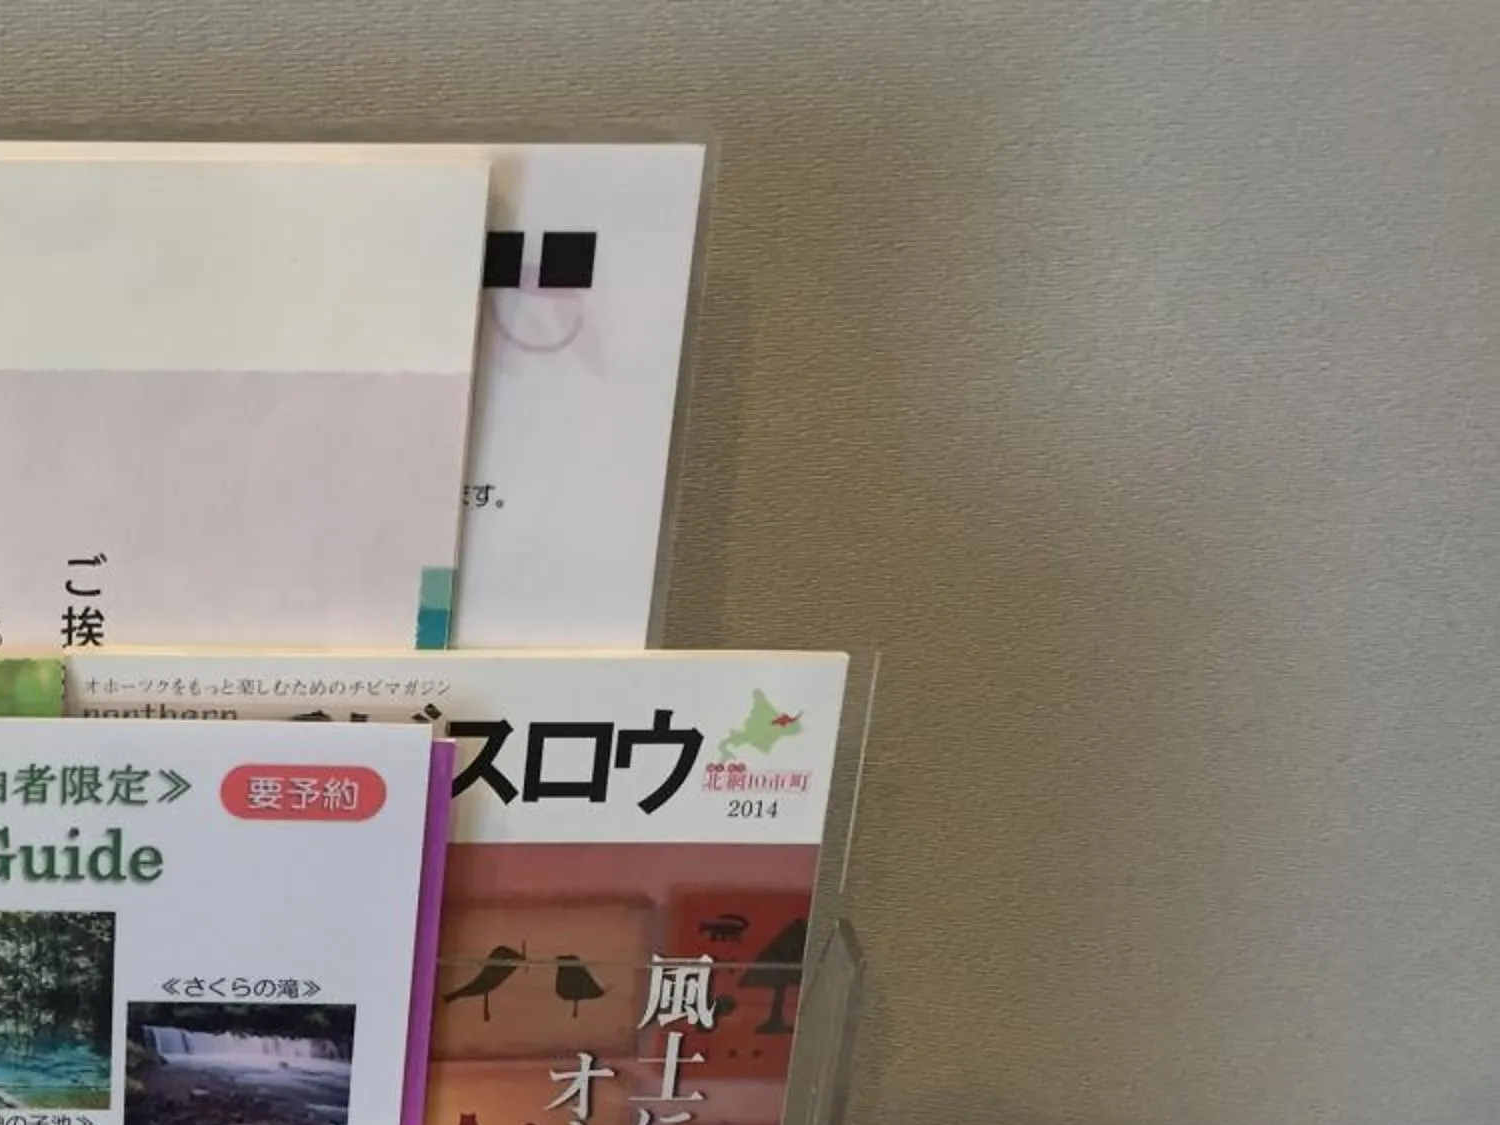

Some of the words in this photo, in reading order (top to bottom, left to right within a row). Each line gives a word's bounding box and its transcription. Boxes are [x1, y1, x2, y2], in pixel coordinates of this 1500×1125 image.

[463, 484, 504, 507] す。
[61, 552, 108, 648] ご挨
[288, 703, 705, 815] スロウ
[247, 776, 359, 811] 要予約
[727, 799, 778, 818] 2014
